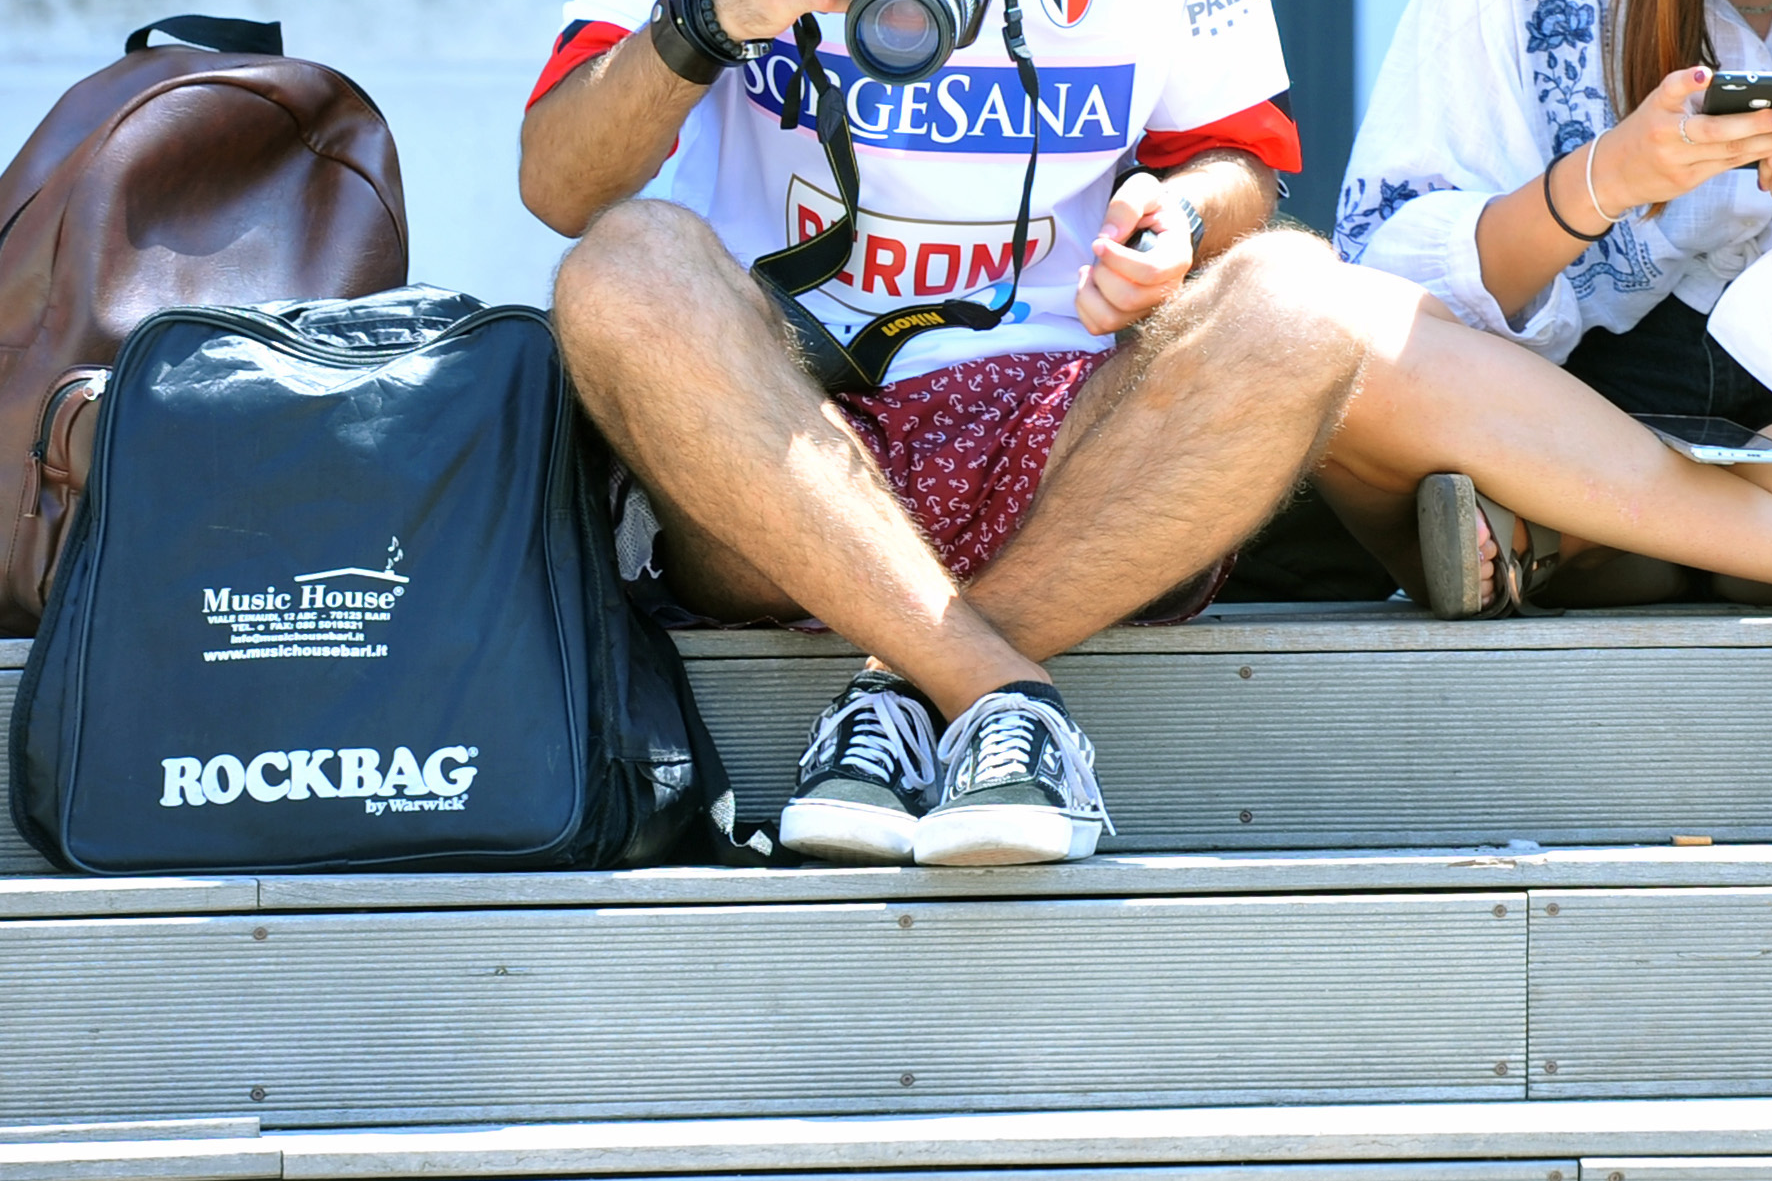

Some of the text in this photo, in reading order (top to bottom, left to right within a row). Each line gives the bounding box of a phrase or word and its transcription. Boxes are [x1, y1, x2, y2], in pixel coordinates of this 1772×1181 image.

[797, 203, 1040, 298] PRONI
[880, 310, 946, 337] Nikon
[202, 584, 396, 613] Music House
[207, 613, 237, 625] VIALE
[364, 611, 392, 621] BARI
[203, 643, 389, 663] www.musichousebari.it
[159, 746, 478, 807] ROCKBAG
[365, 796, 466, 816] by Warwick
